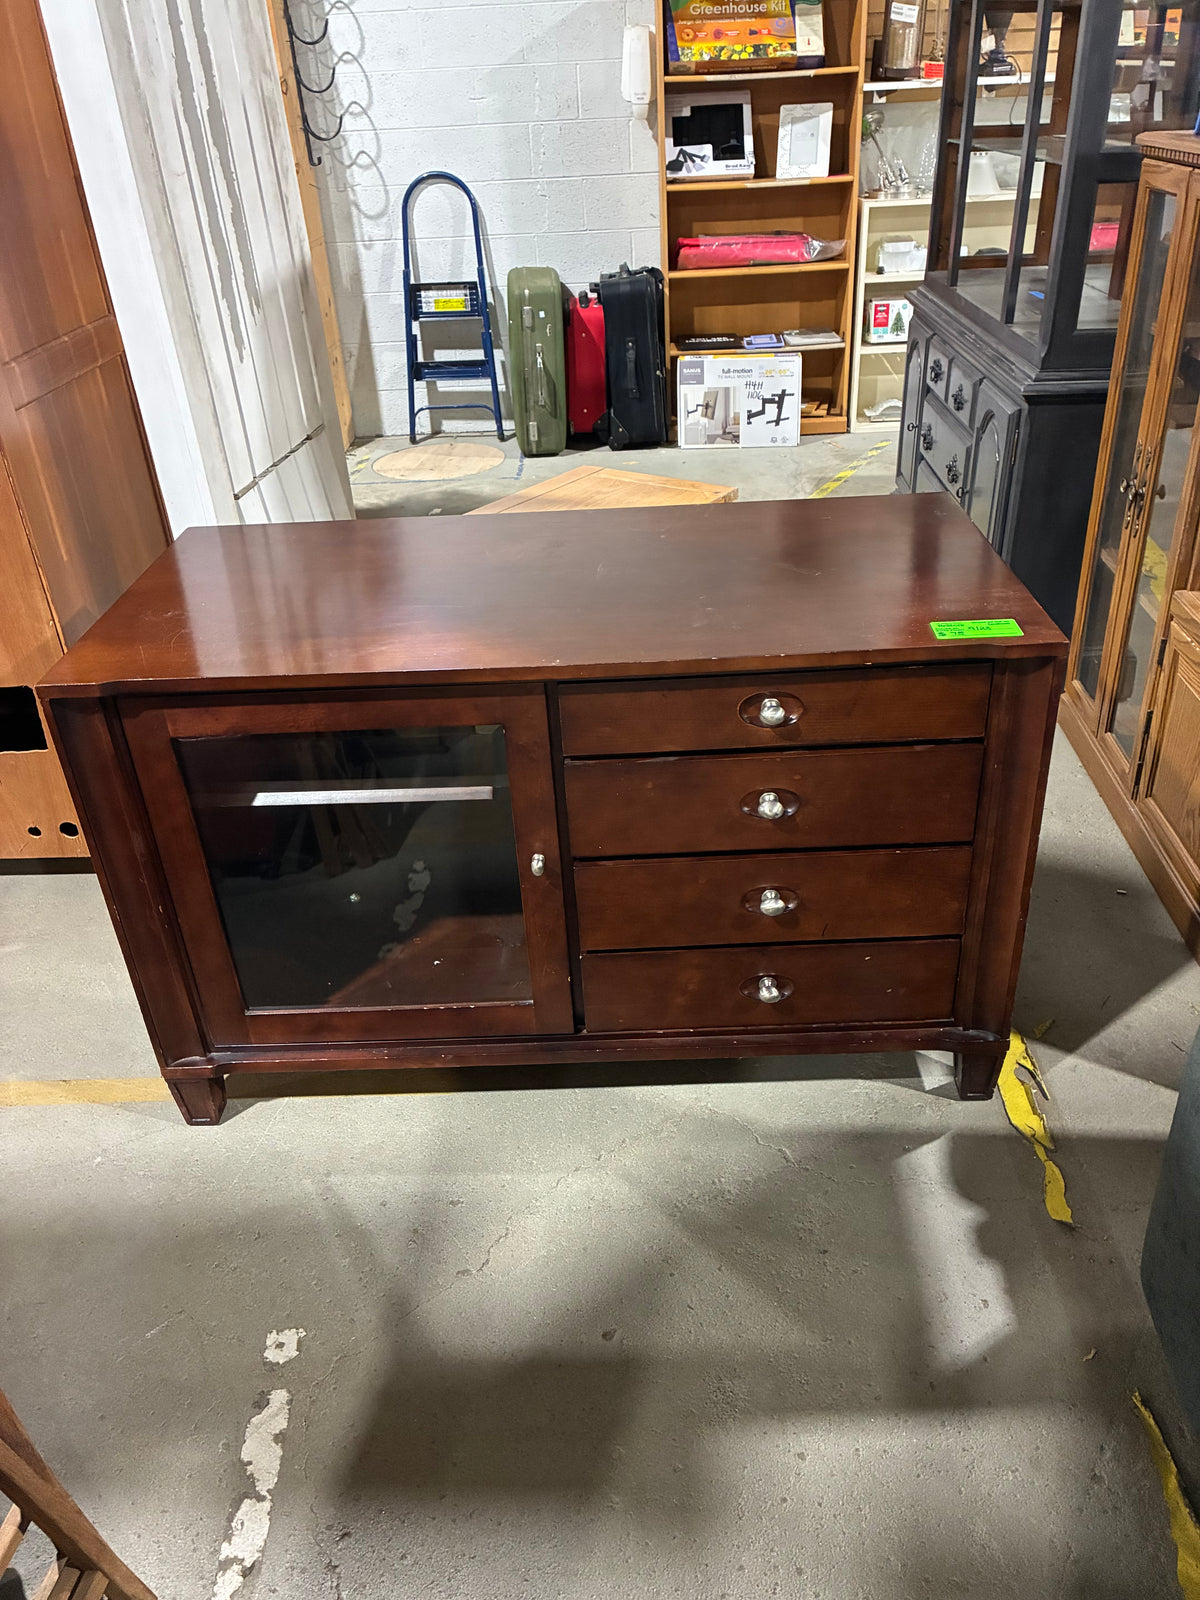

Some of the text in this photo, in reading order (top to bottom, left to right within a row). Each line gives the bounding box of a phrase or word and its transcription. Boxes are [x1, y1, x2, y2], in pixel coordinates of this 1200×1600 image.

[690, 1, 786, 15] Greenhouse Kit
[745, 380, 763, 390] H4H
[747, 390, 765, 400] 1106
